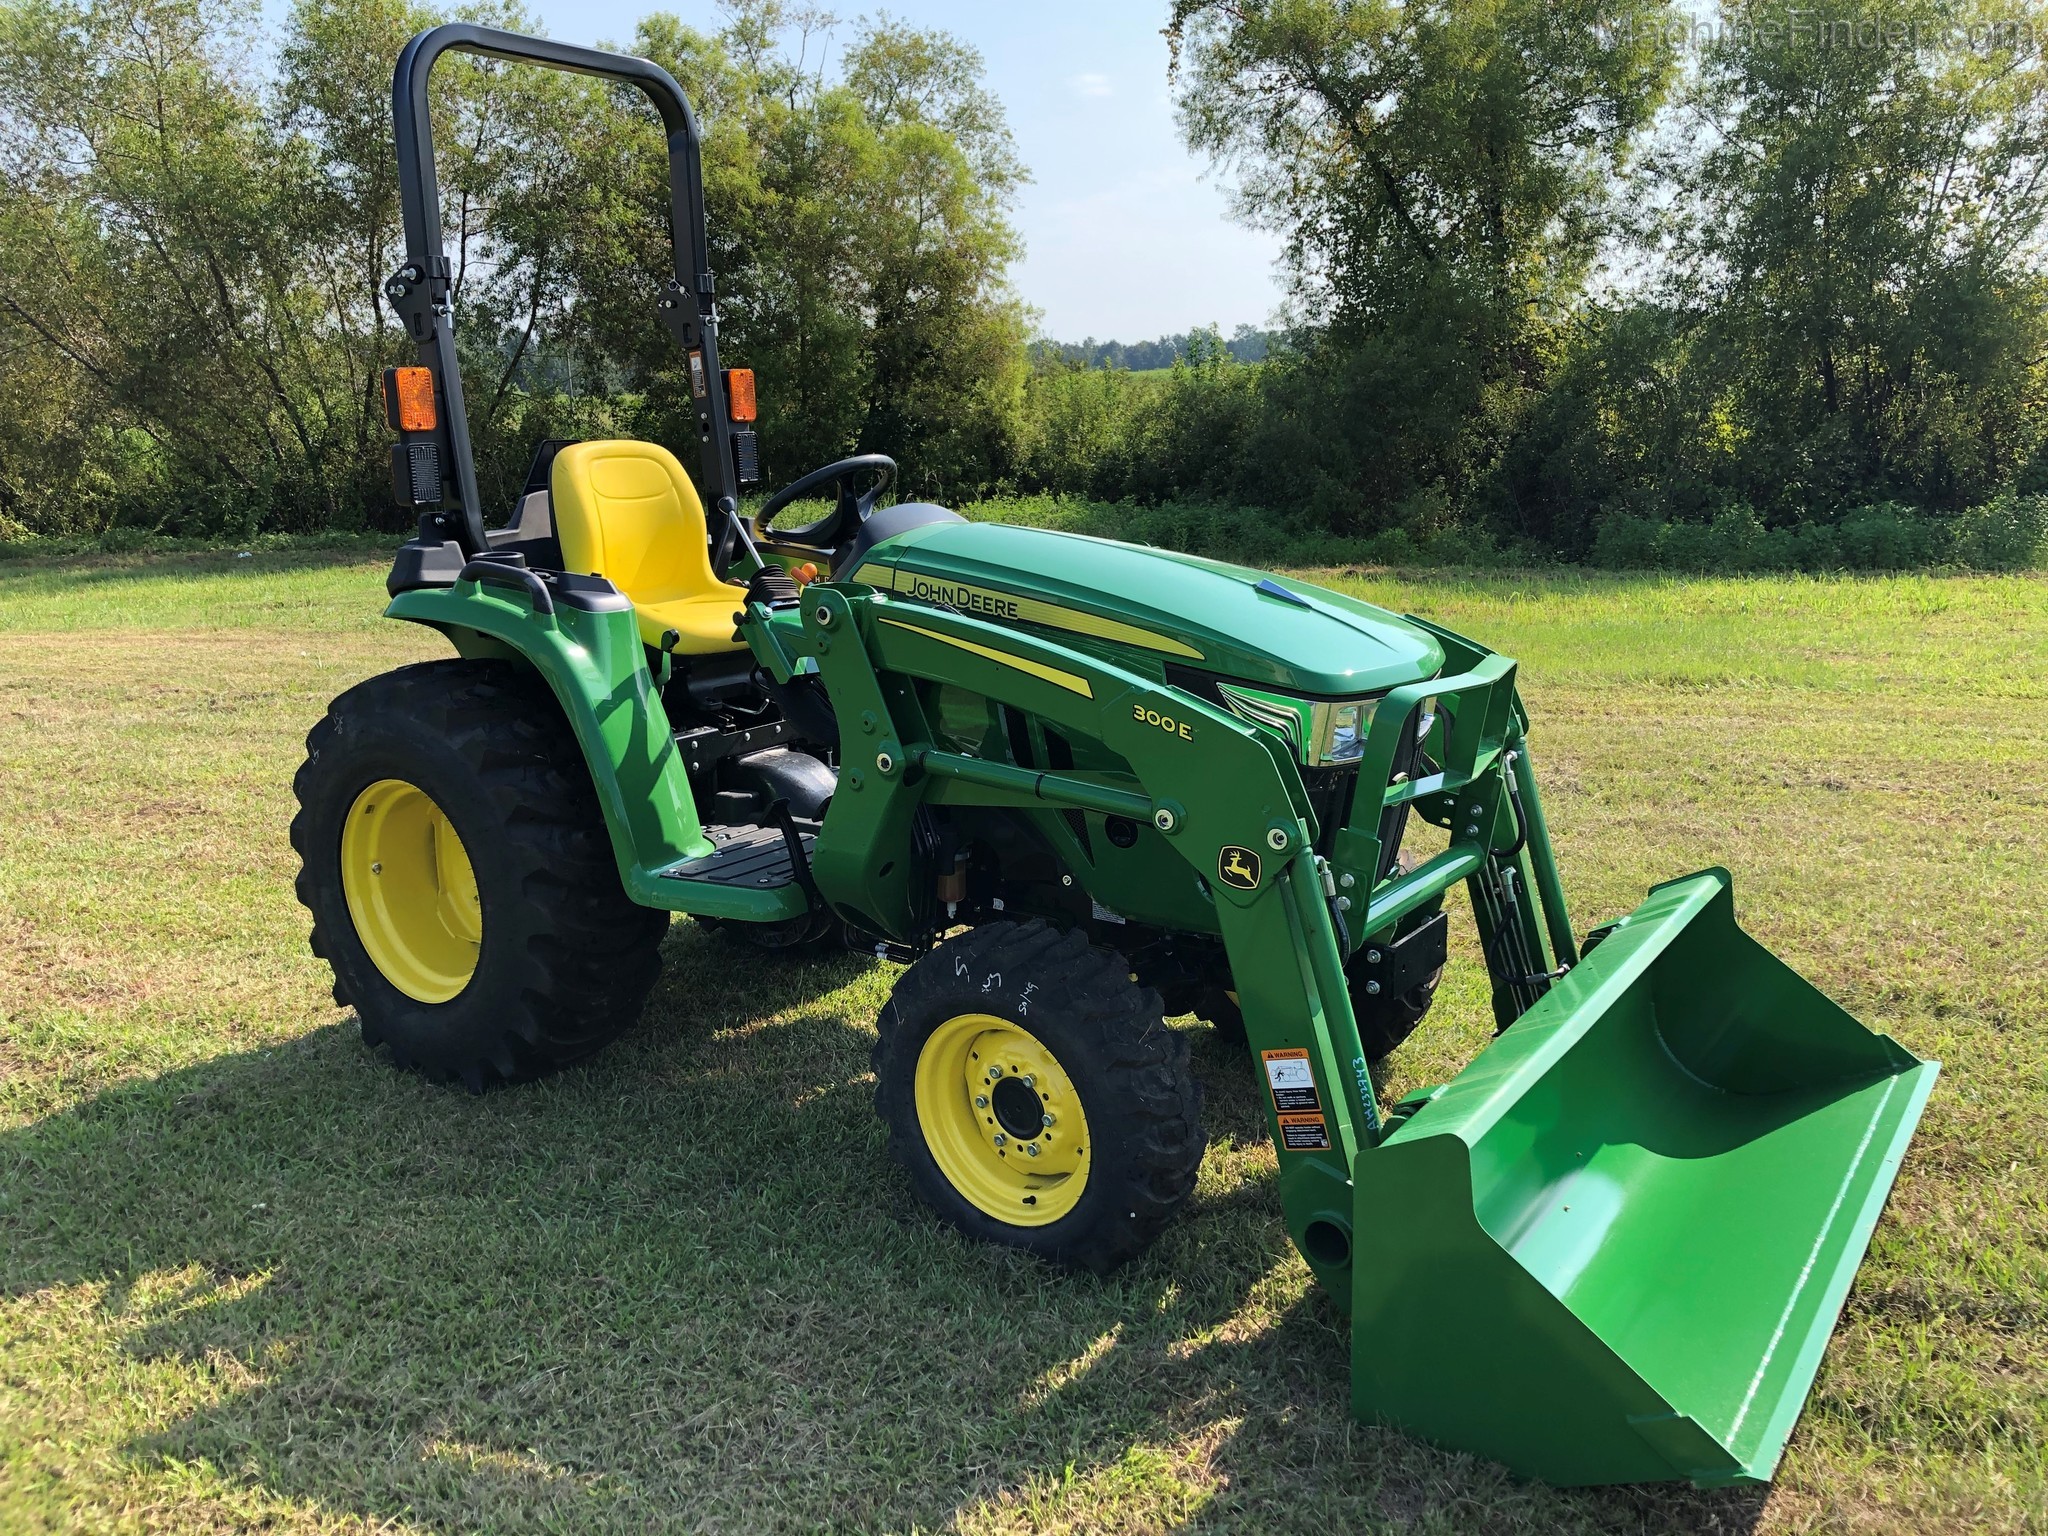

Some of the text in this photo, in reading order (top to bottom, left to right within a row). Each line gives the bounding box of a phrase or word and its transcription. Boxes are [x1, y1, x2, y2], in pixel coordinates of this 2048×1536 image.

[907, 577, 1019, 618] JOHN DEERE
[1274, 1051, 1304, 1059] WARNING
[1291, 1116, 1320, 1124] WARNING
